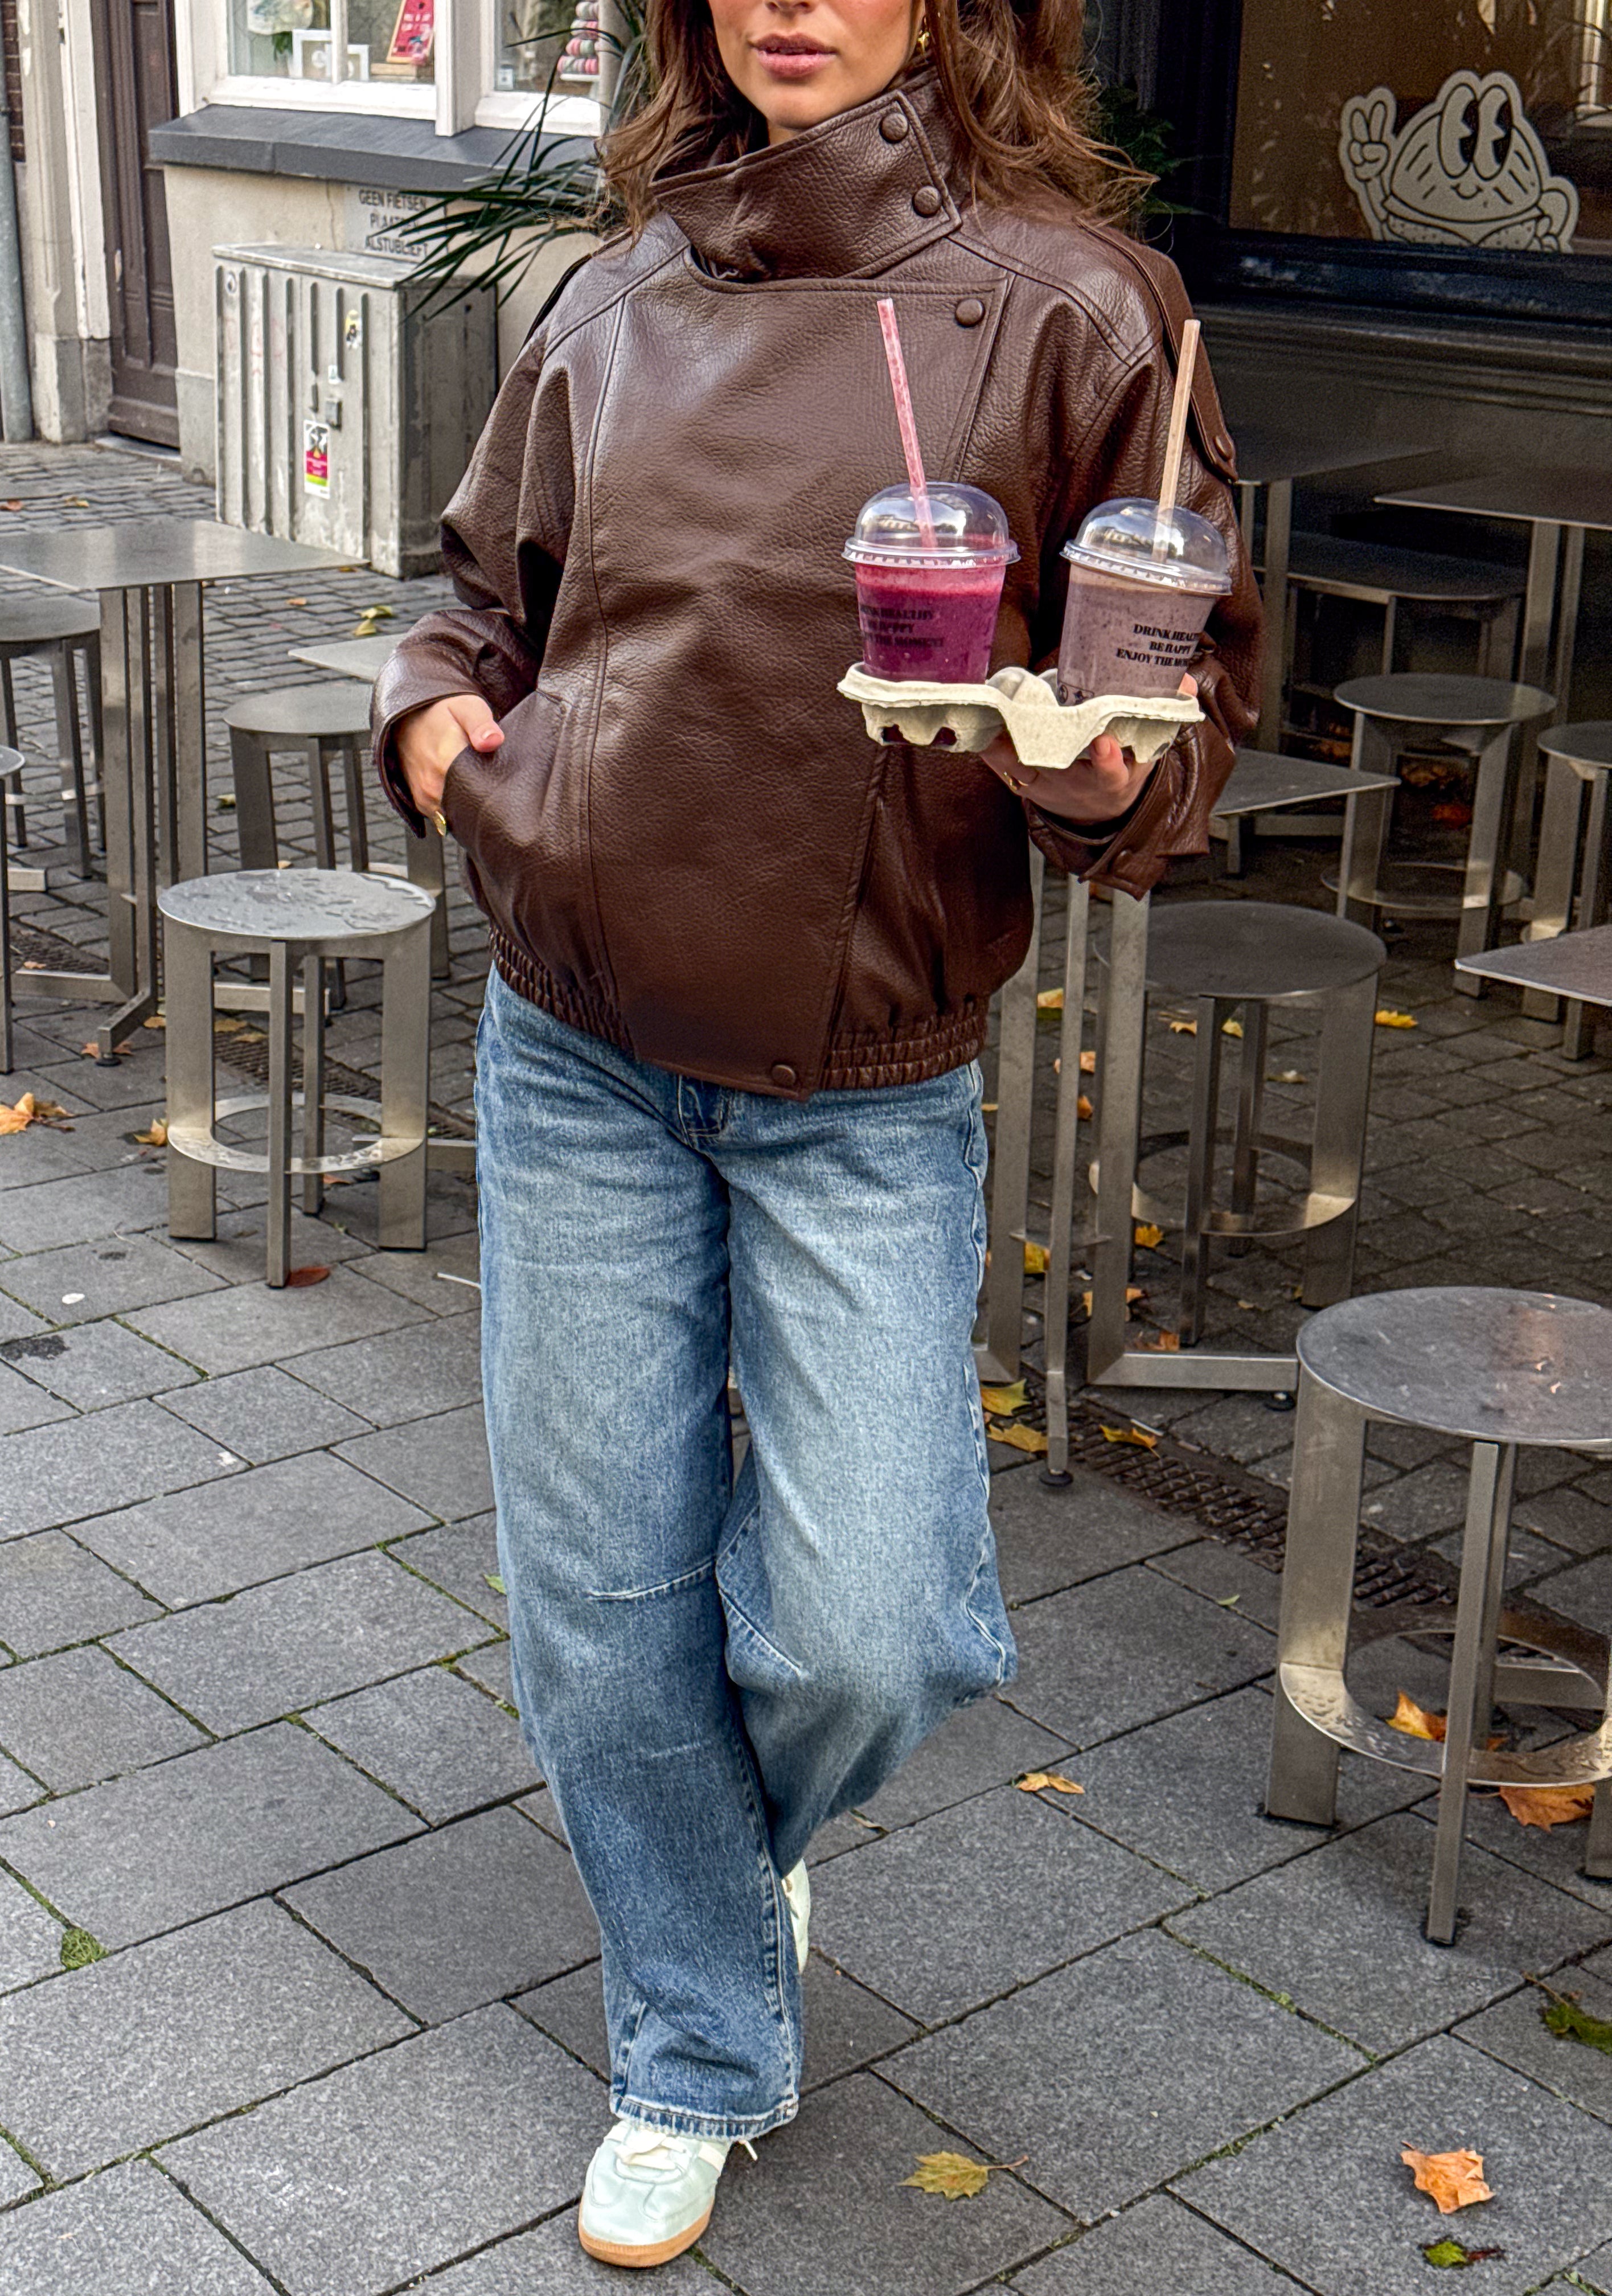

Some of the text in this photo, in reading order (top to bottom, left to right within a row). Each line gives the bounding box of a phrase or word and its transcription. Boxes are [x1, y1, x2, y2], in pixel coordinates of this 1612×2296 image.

[359, 189, 426, 211] GEEN FIETSEN
[1133, 624, 1200, 642] DRINK HEALT
[1149, 641, 1165, 652] BE
[1116, 647, 1152, 663] ENJOY
[1154, 655, 1174, 667] THE
